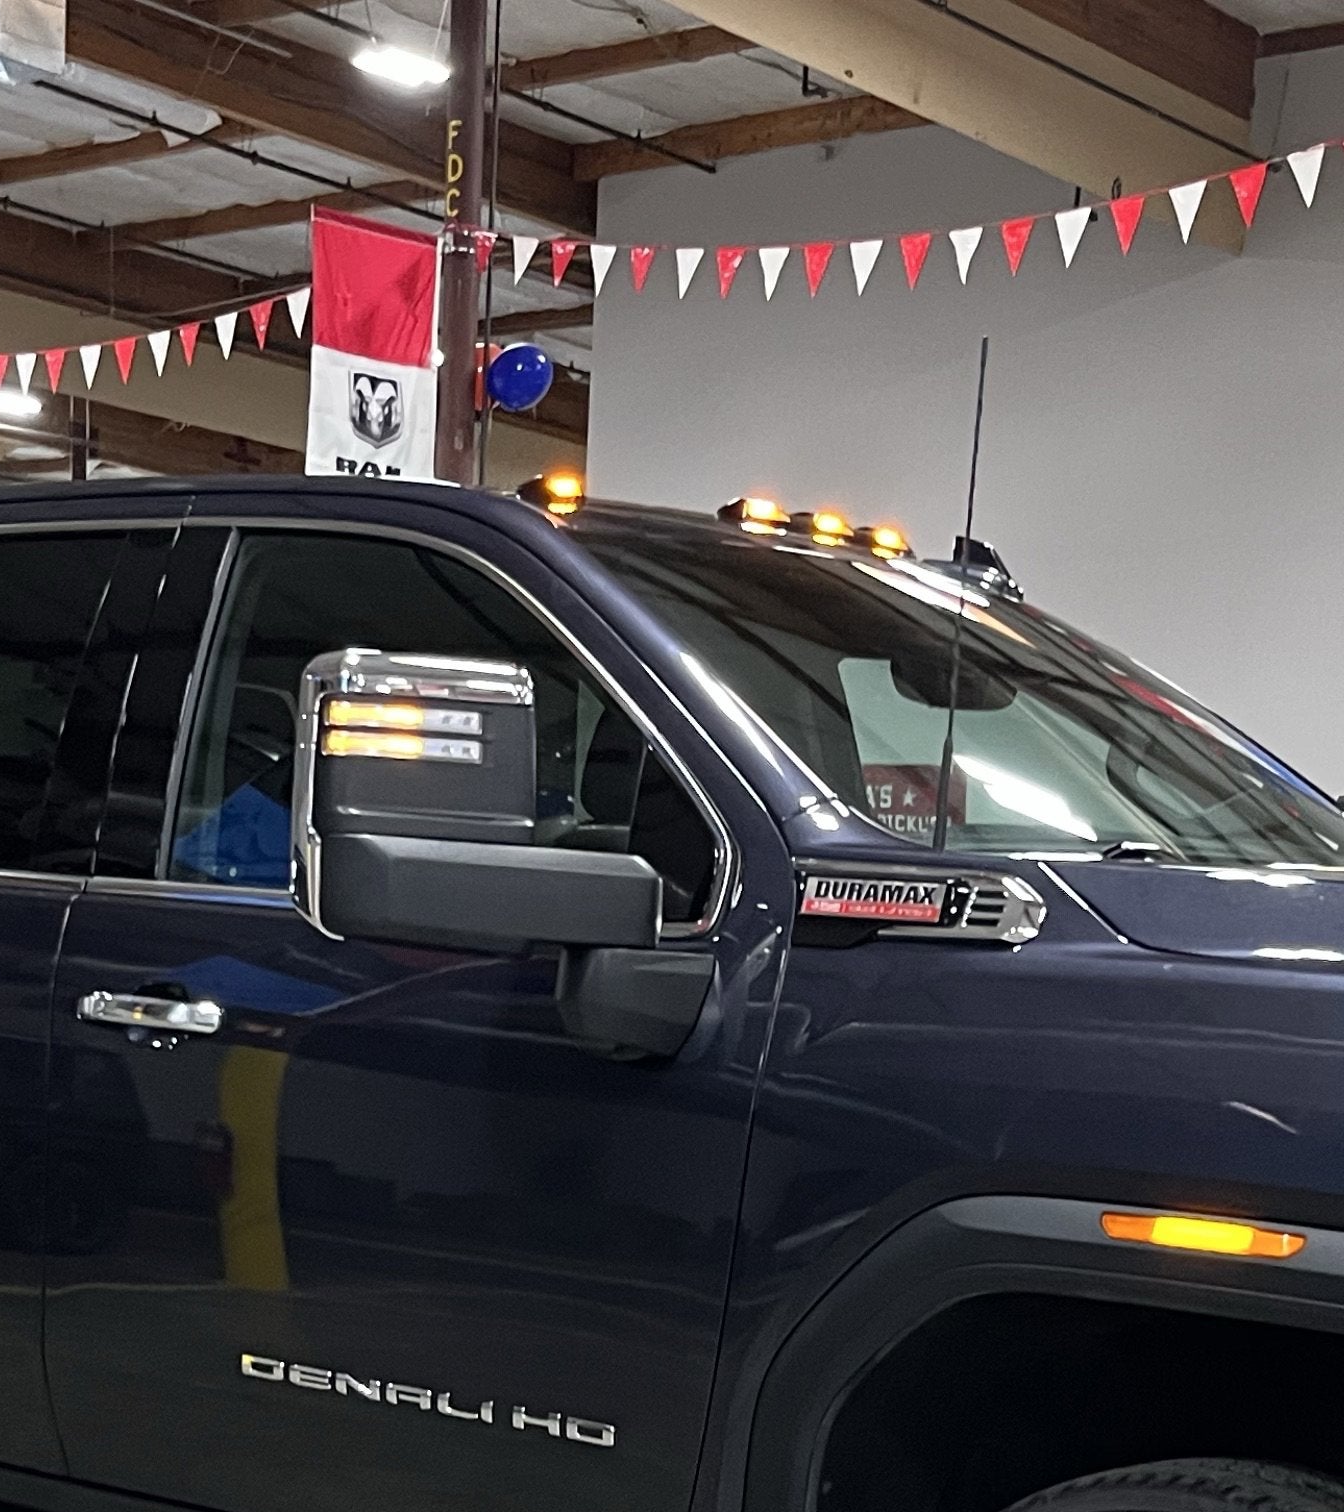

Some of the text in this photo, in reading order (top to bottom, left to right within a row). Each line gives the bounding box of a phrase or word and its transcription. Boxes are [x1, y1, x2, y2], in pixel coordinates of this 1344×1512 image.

[814, 879, 939, 905] DURAMAX
[240, 1352, 617, 1448] DENALI HD
